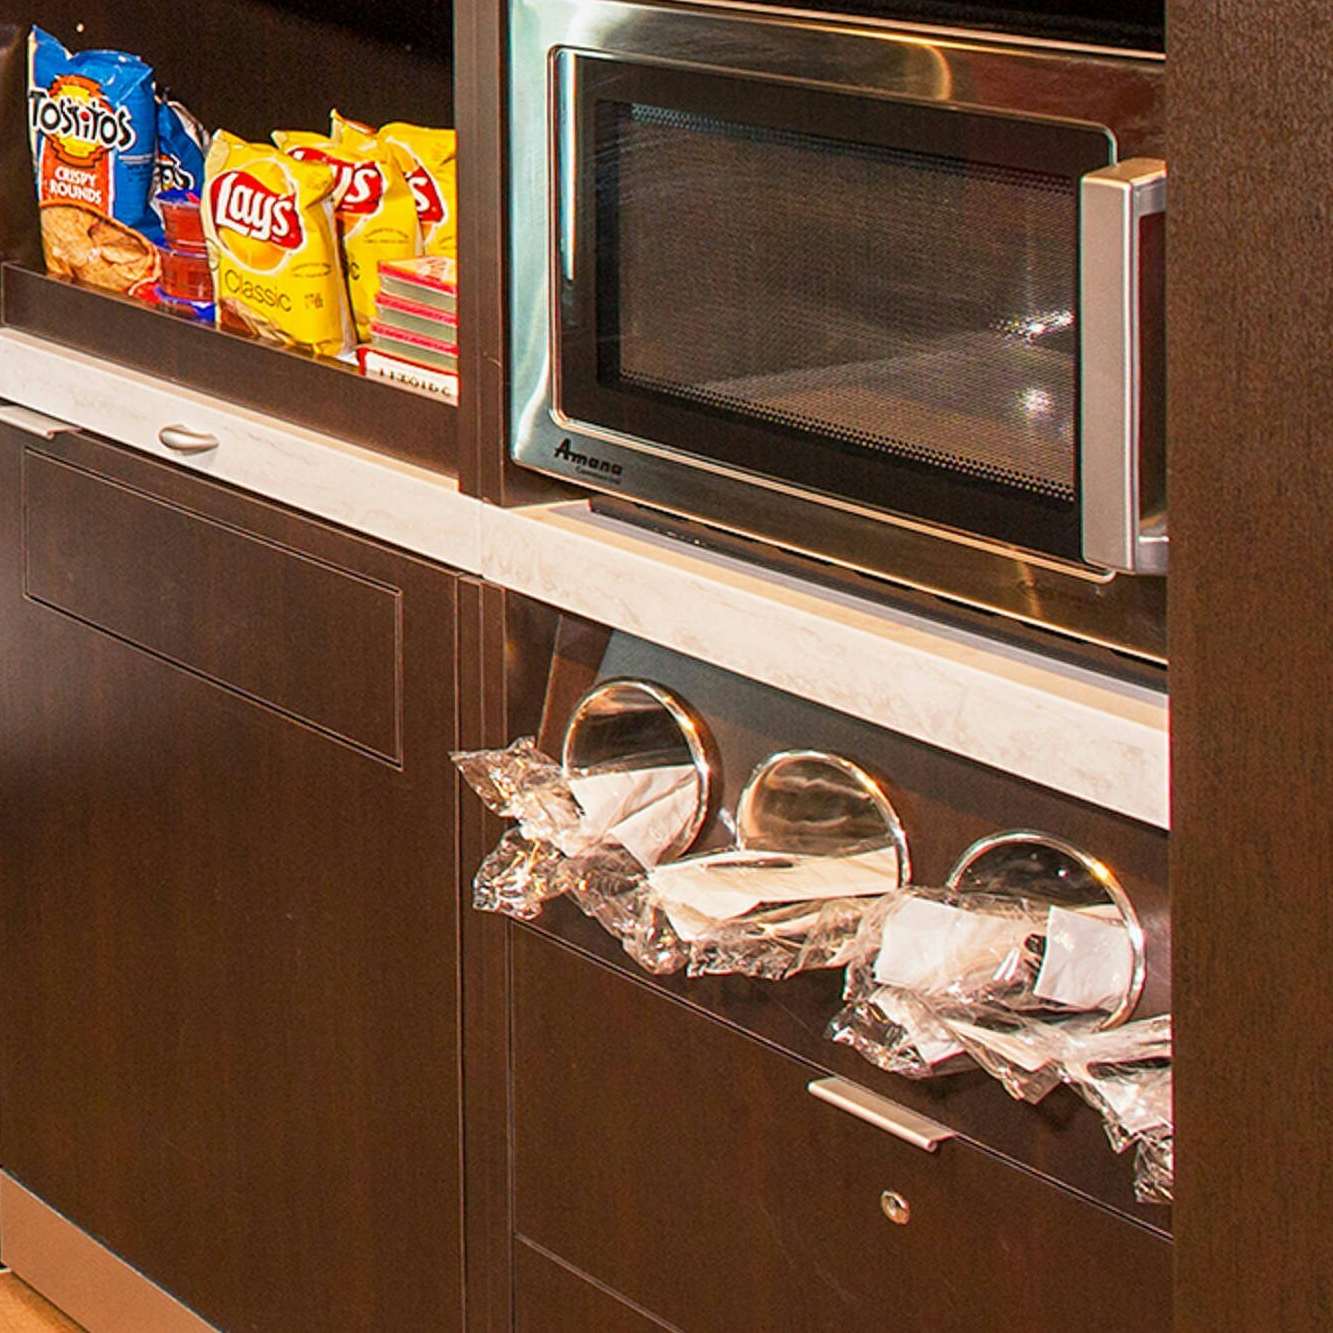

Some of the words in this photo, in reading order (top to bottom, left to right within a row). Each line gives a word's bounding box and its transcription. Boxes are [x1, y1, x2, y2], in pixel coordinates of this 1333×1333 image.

[50, 180, 102, 204] ROUNDS
[54, 165, 97, 187] CRISPY
[215, 173, 294, 242] Lay's
[224, 268, 293, 314] Classic
[553, 437, 624, 476] Amana
